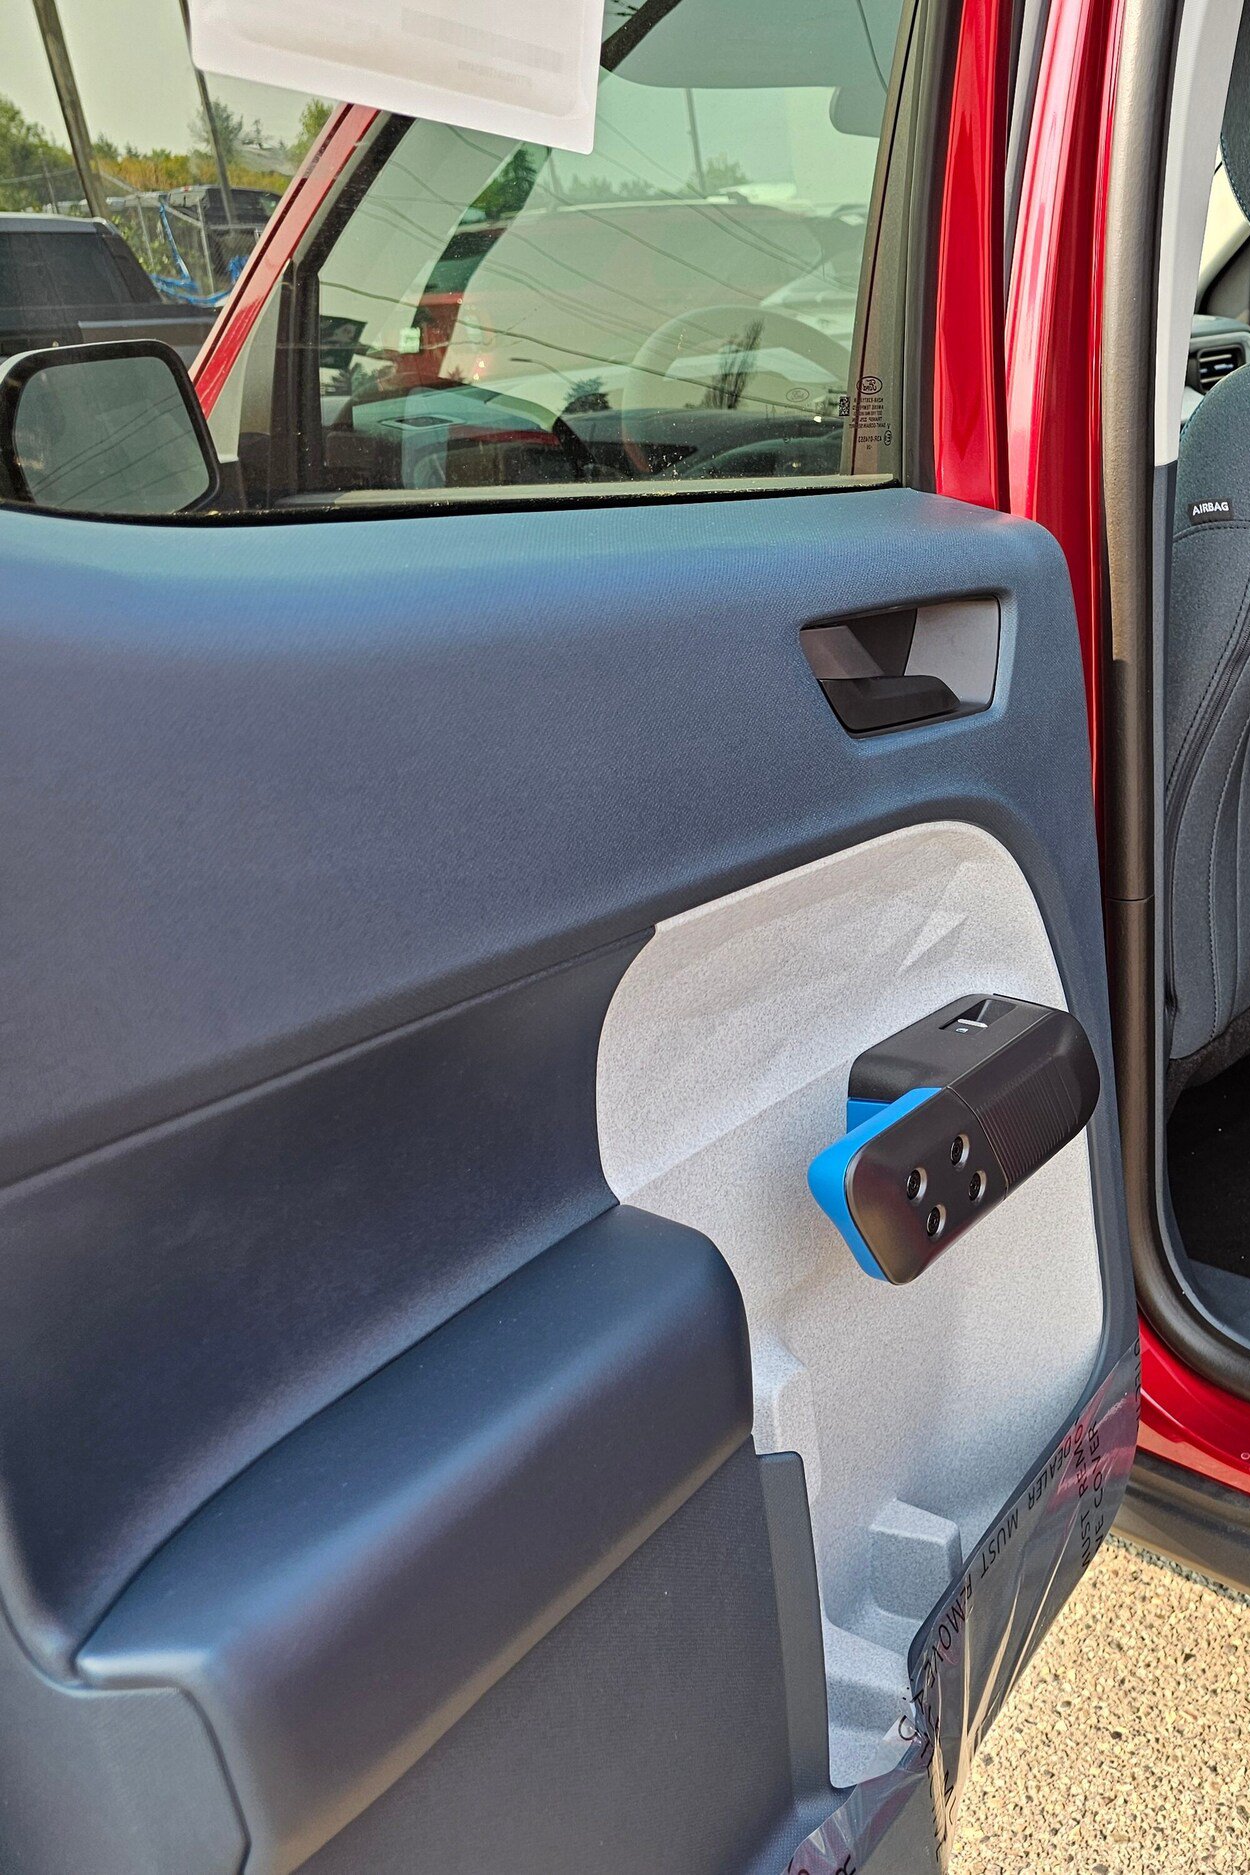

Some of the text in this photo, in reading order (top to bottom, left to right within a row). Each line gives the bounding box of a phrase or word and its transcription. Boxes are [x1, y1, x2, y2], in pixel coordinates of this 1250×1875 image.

[1192, 501, 1229, 516] AIRBAG
[1027, 1434, 1073, 1511] DEALER
[980, 1508, 1020, 1579] MUST
